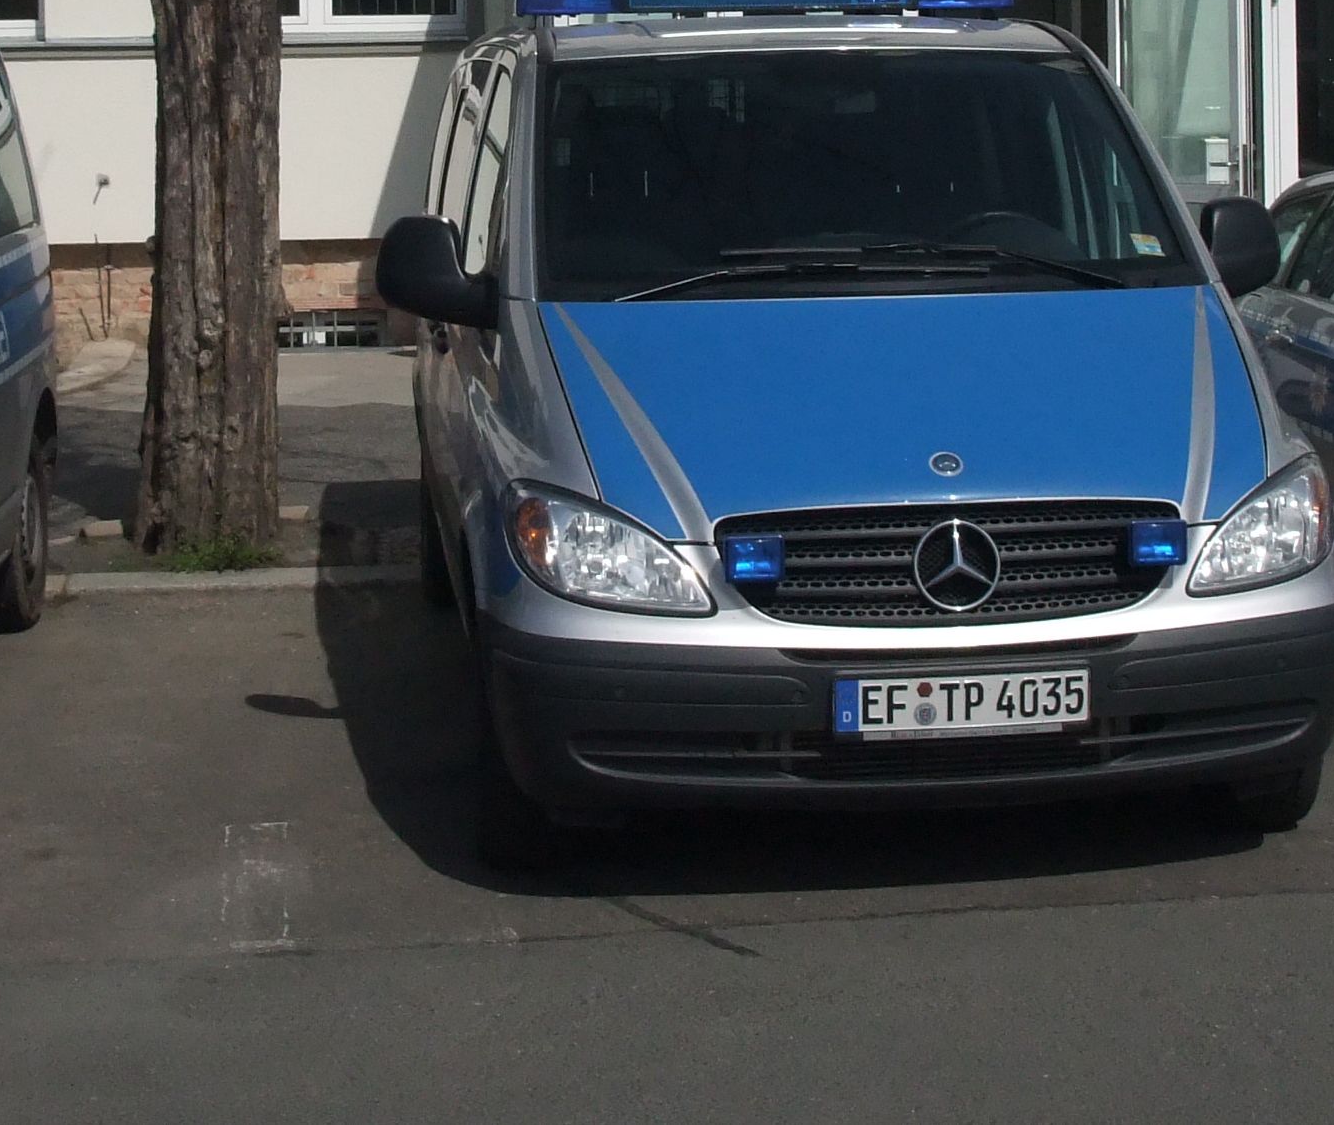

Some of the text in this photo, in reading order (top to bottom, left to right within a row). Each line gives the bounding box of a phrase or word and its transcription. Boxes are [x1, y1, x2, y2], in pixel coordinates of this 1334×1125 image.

[861, 675, 1085, 725] EF TP 4035
[842, 711, 852, 723] D
